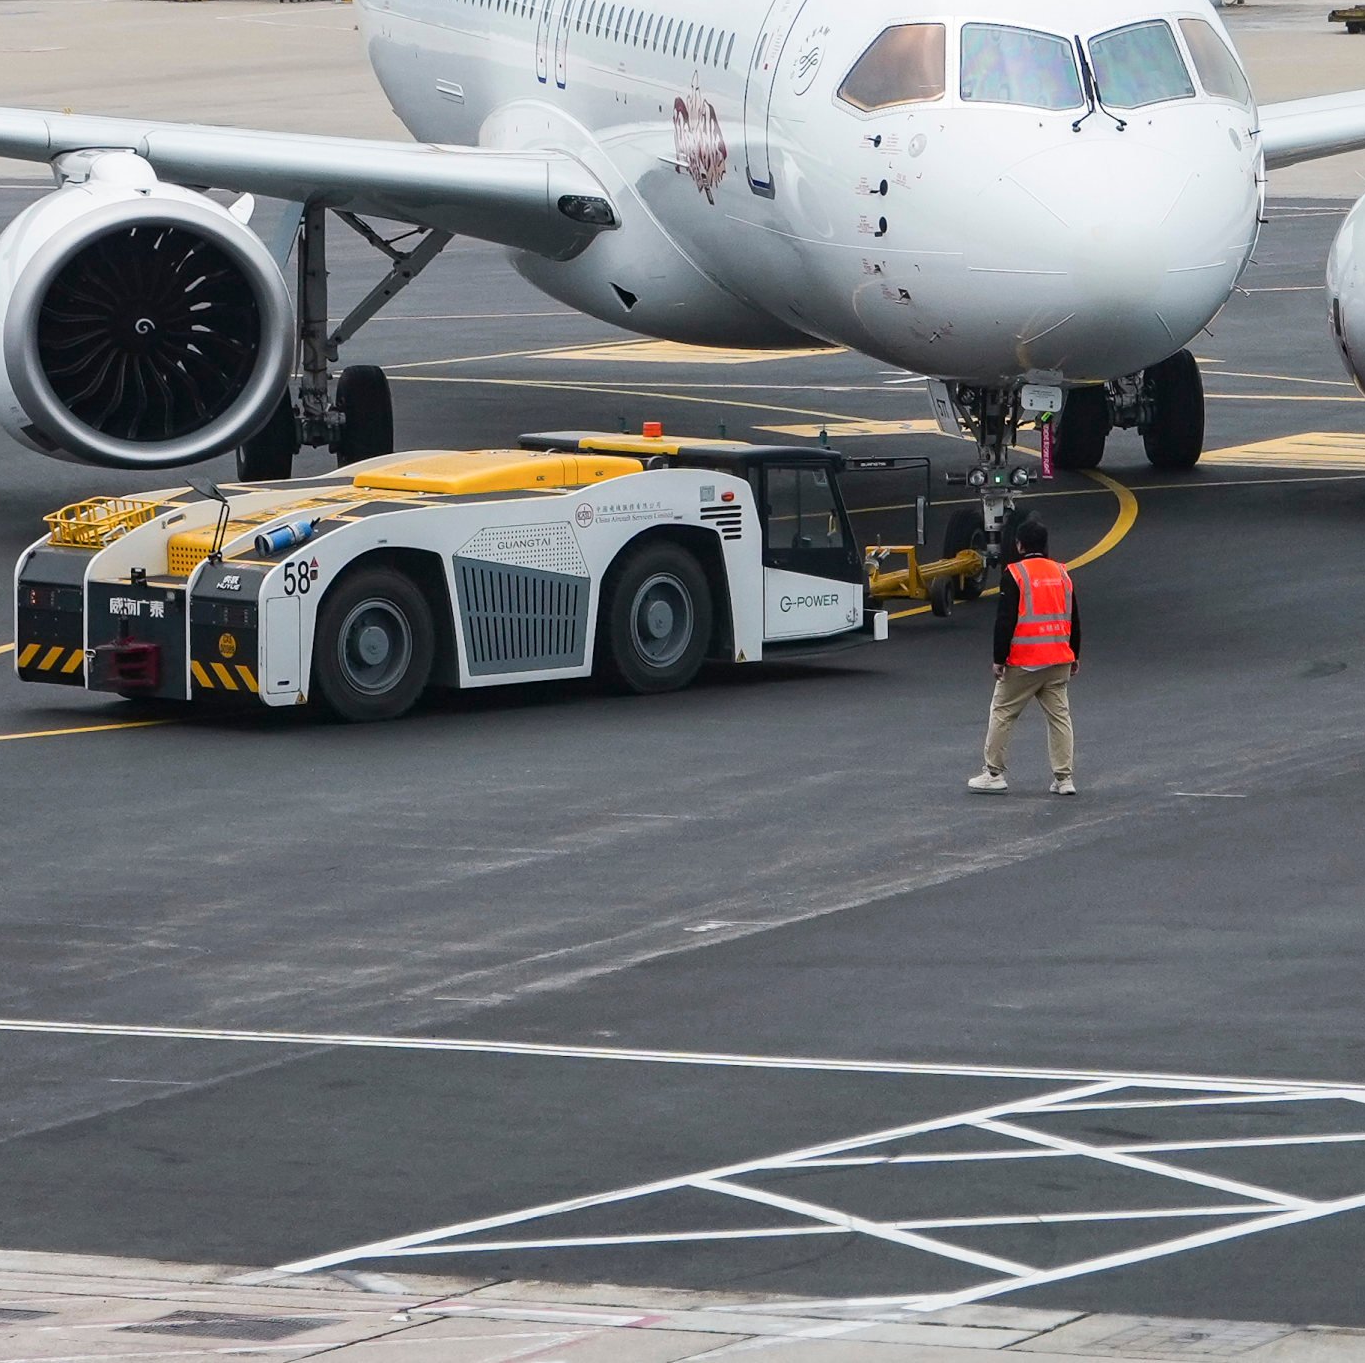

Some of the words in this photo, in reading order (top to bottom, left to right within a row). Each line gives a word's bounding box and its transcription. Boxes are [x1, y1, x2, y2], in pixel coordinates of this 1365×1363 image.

[632, 513, 653, 521] Services
[497, 538, 551, 550] GUANGTAI
[283, 560, 311, 595] 58
[109, 597, 165, 618] 威海广泰
